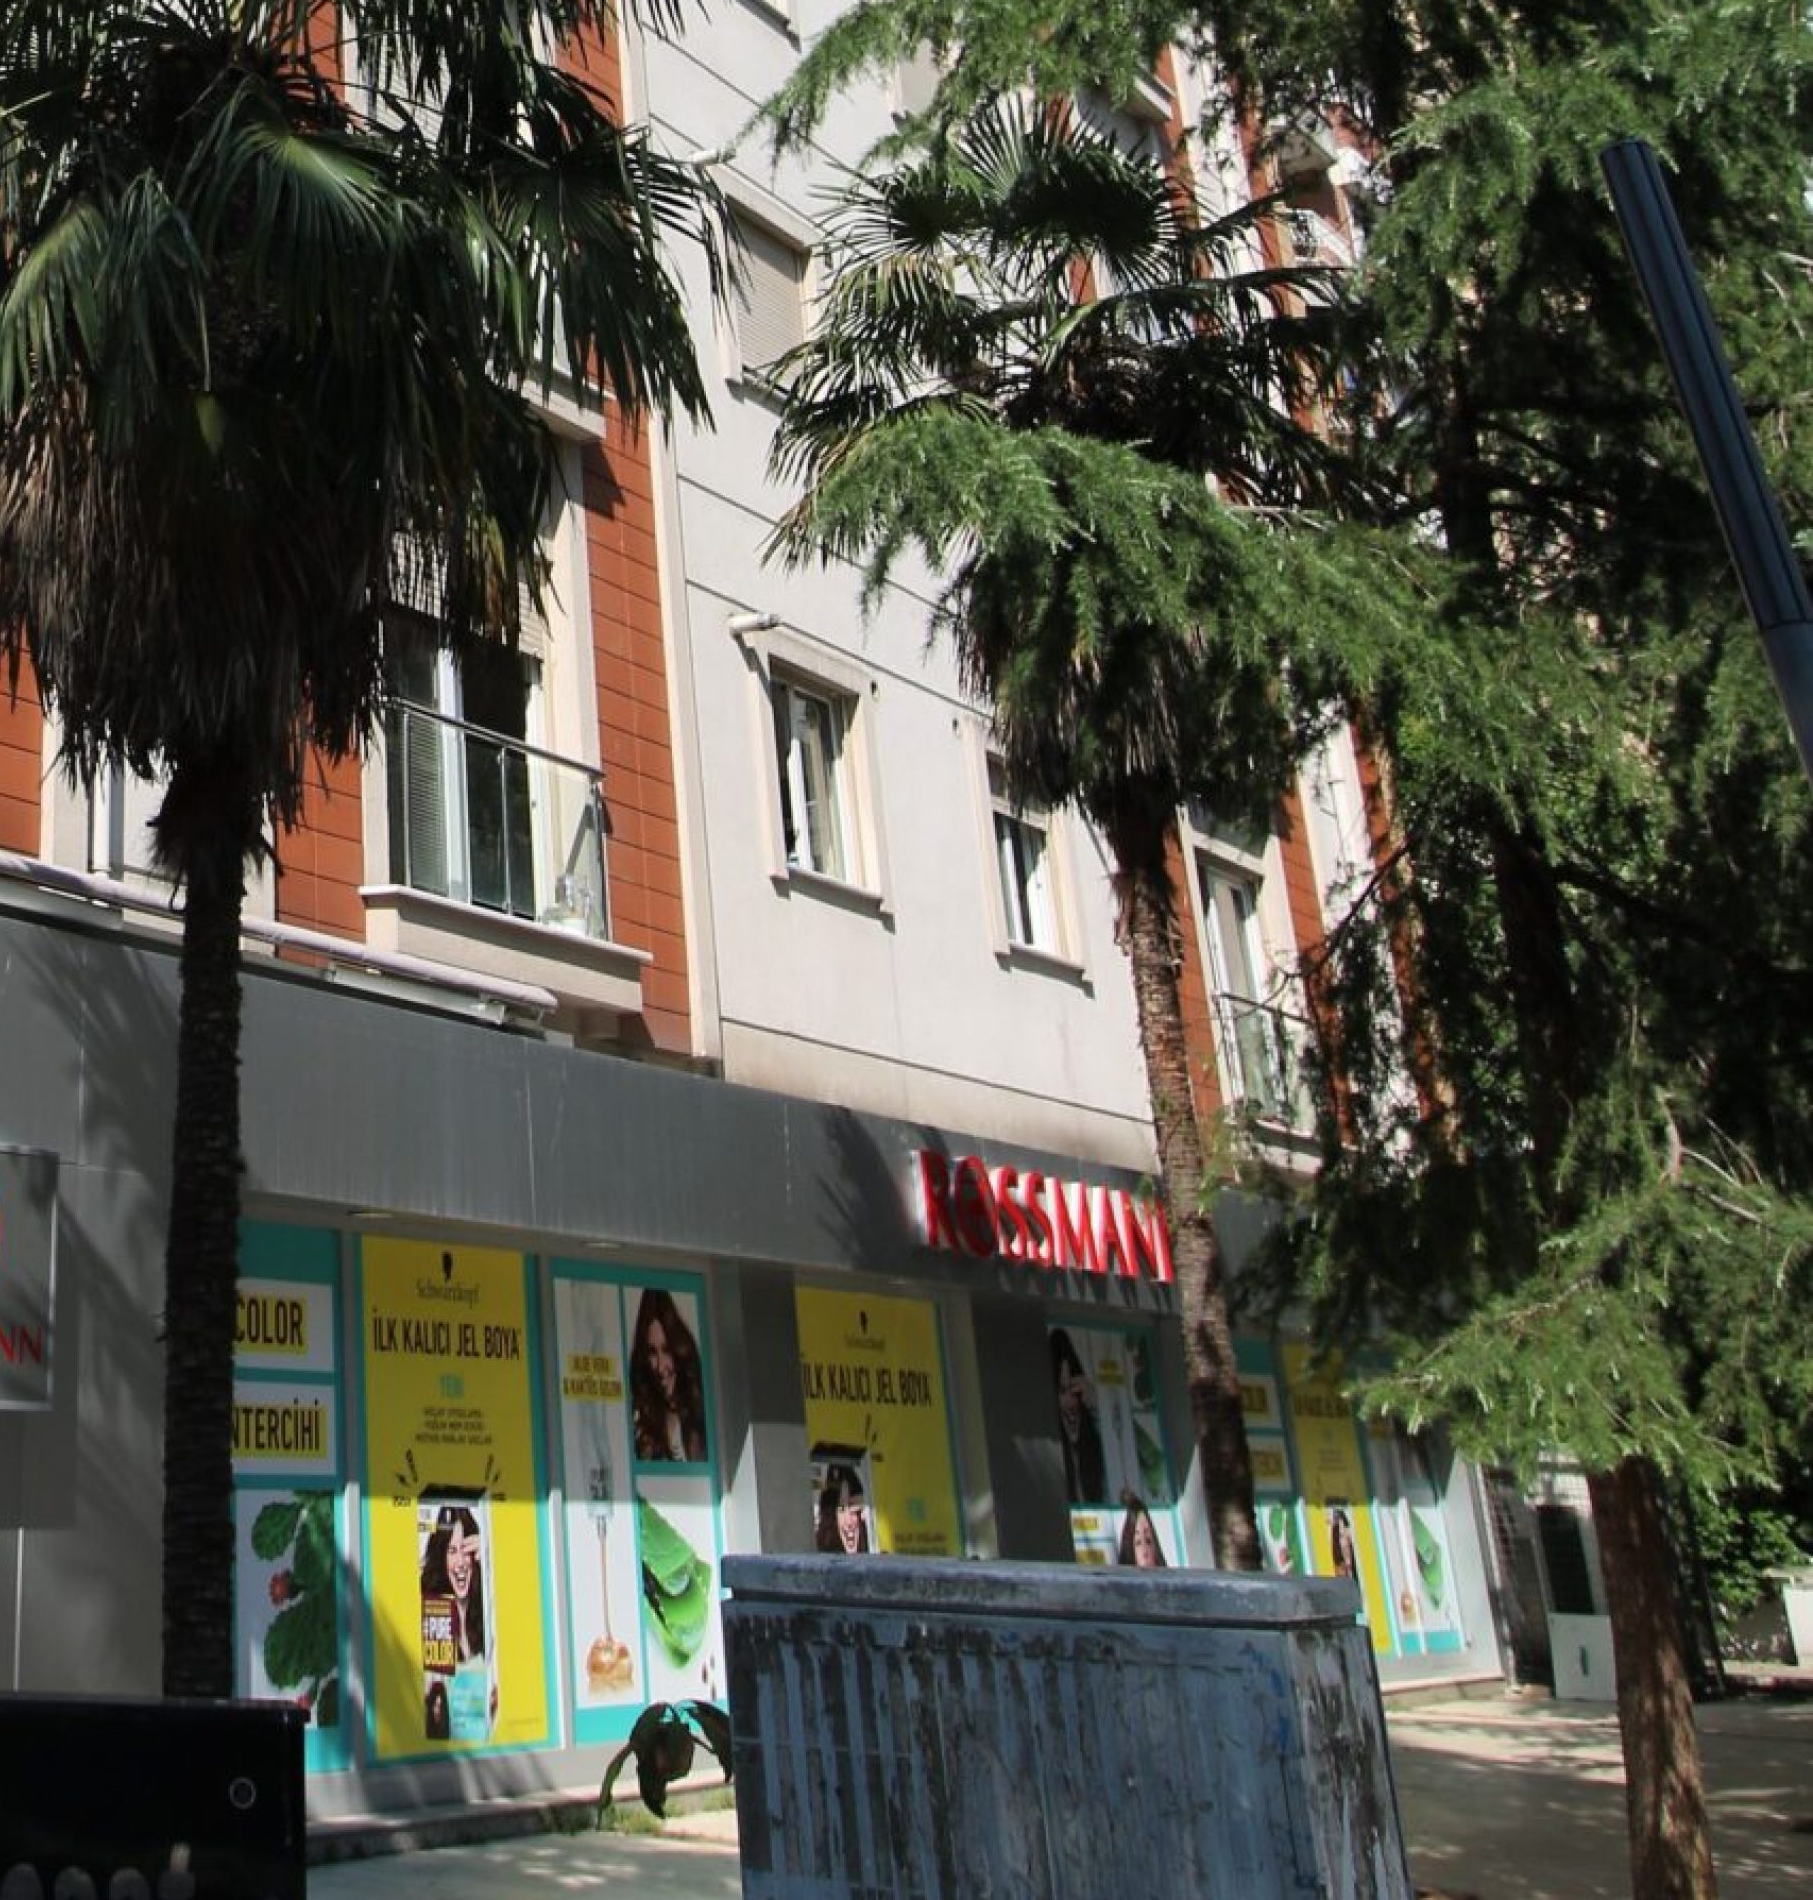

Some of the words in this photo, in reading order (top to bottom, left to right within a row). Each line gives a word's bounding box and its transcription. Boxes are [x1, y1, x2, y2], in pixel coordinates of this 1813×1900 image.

[914, 1148, 1175, 1285] ROSSMAN
[234, 1297, 304, 1347] COLOR
[372, 1305, 399, 1353] İLK
[401, 1316, 452, 1357] KALICI
[456, 1322, 481, 1359] JEL
